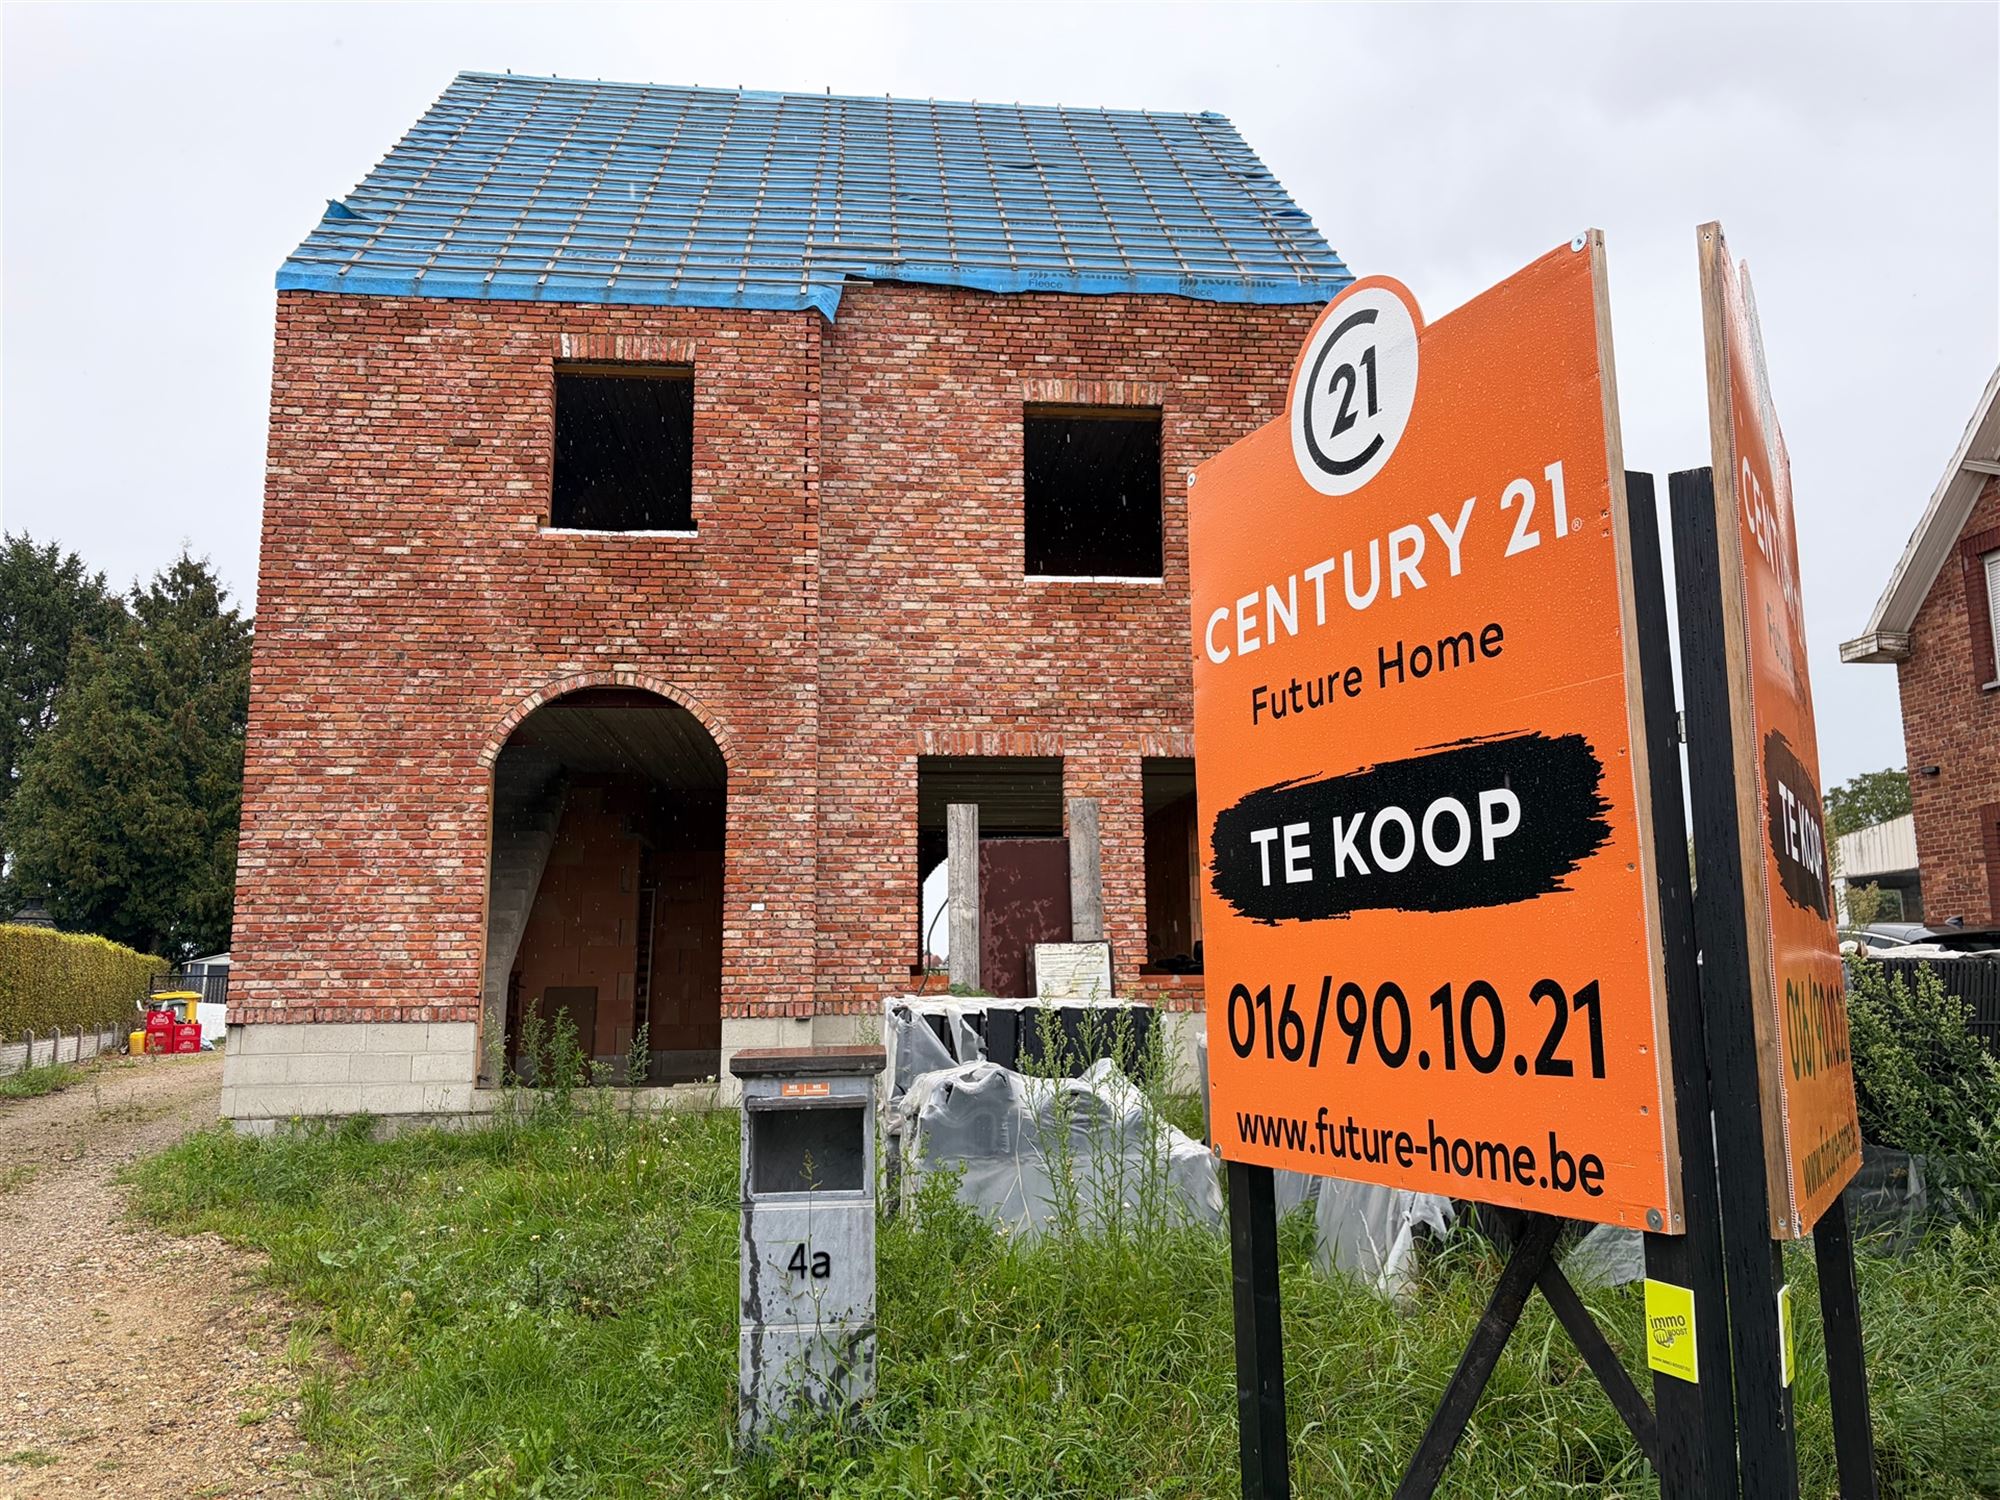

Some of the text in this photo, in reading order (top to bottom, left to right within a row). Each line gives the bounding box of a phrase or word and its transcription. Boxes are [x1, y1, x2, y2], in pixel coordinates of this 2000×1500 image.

[1178, 286, 1213, 297] Fleece
[1328, 345, 1380, 440] 21
[1205, 496, 1477, 664] CENTURY
[1252, 621, 1505, 726] Future Home
[1250, 788, 1521, 887] TE KOOP
[1778, 780, 1799, 862] TE
[1227, 975, 1606, 1079] 016/90.10.21
[1236, 1106, 1605, 1197] www.future-home.be
[787, 1243, 831, 1281] 4a
[1649, 1315, 1685, 1329] immo
